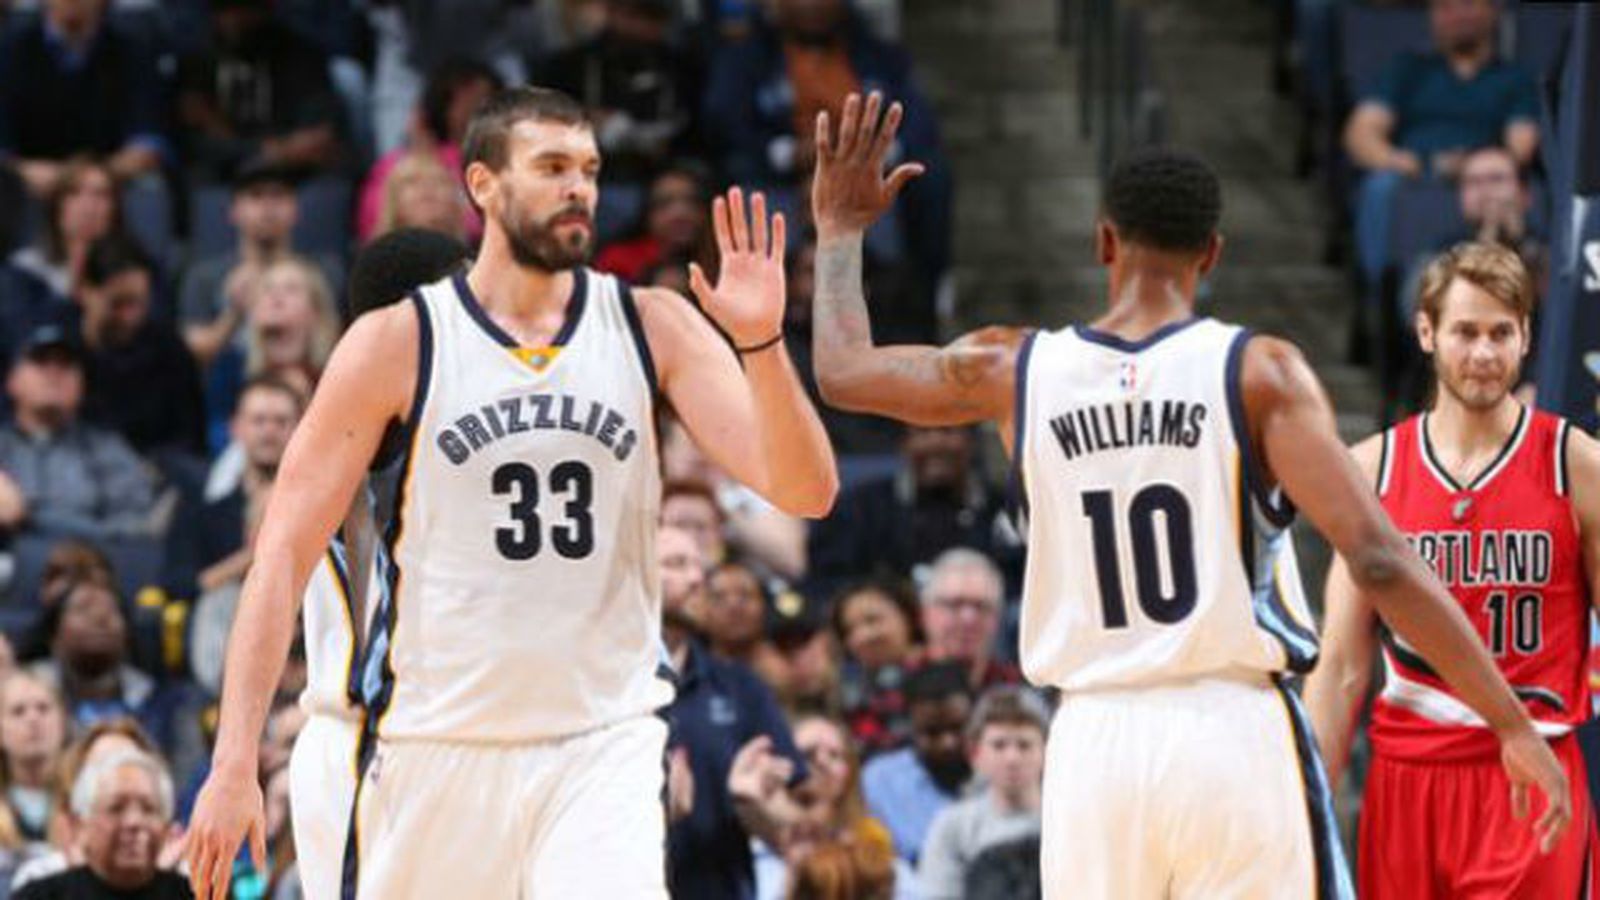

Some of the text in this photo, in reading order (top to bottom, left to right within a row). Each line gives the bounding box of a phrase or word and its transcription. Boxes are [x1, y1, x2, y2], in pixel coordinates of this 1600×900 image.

[437, 394, 637, 465] GRIZZLIES
[1050, 401, 1206, 461] WILLIAMS
[492, 461, 594, 560] 33
[1081, 484, 1199, 629] 10
[1407, 531, 1552, 586] RTLAND
[1483, 592, 1542, 656] 10
